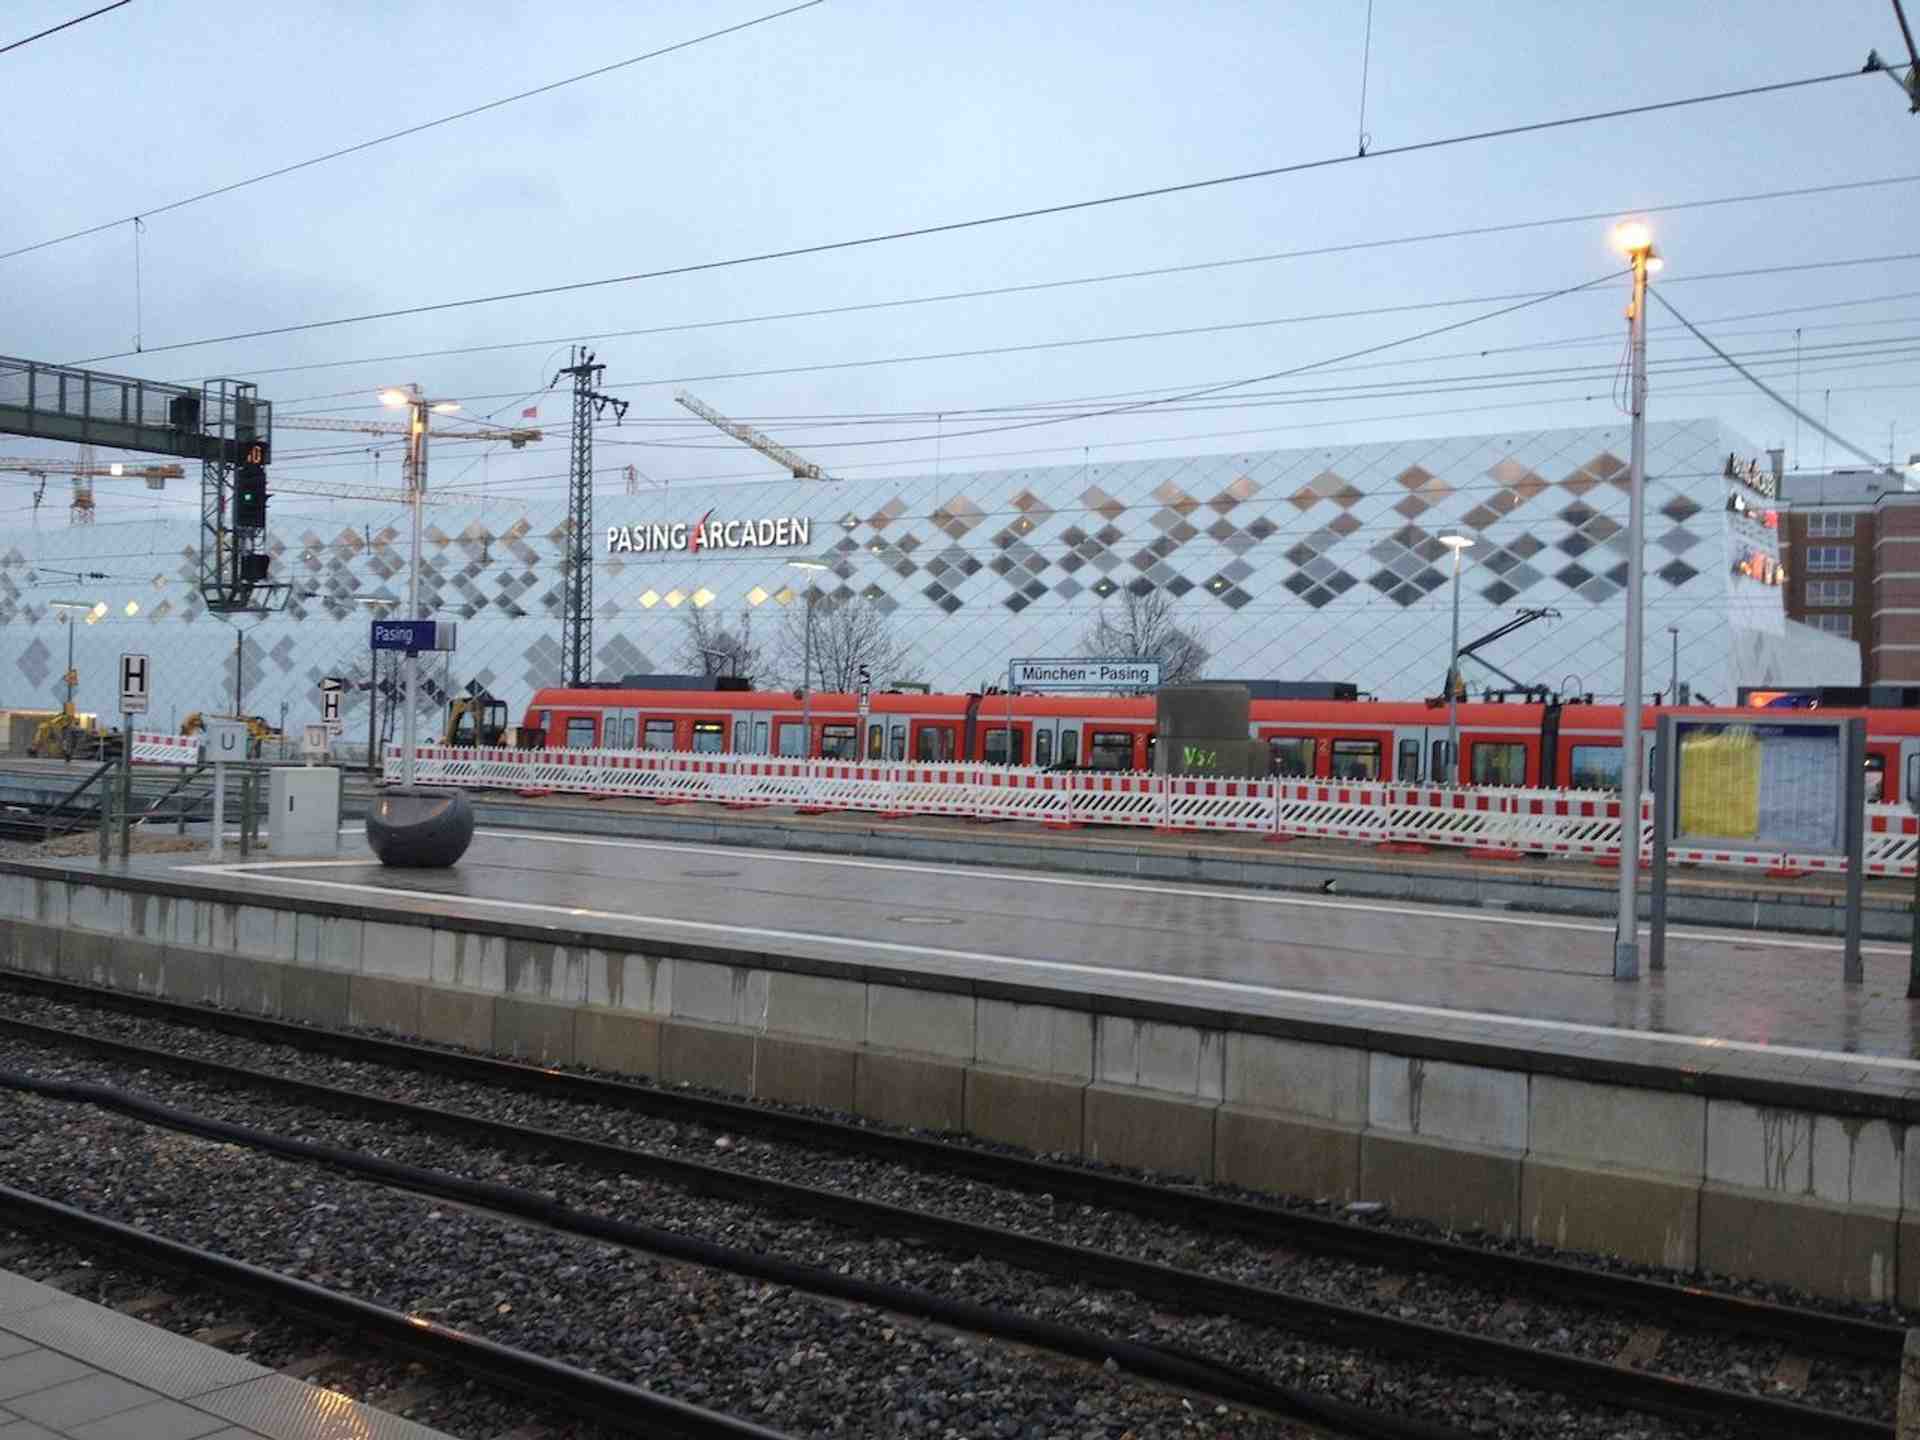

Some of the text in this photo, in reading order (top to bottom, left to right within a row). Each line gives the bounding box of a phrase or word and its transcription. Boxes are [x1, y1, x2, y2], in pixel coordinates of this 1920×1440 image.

[607, 508, 810, 553] PASING ARCADEN
[375, 625, 414, 645] Pasing
[123, 657, 146, 693] H
[324, 692, 338, 718] H
[220, 732, 236, 751] U
[310, 733, 321, 747] U
[1319, 739, 1328, 752] 2
